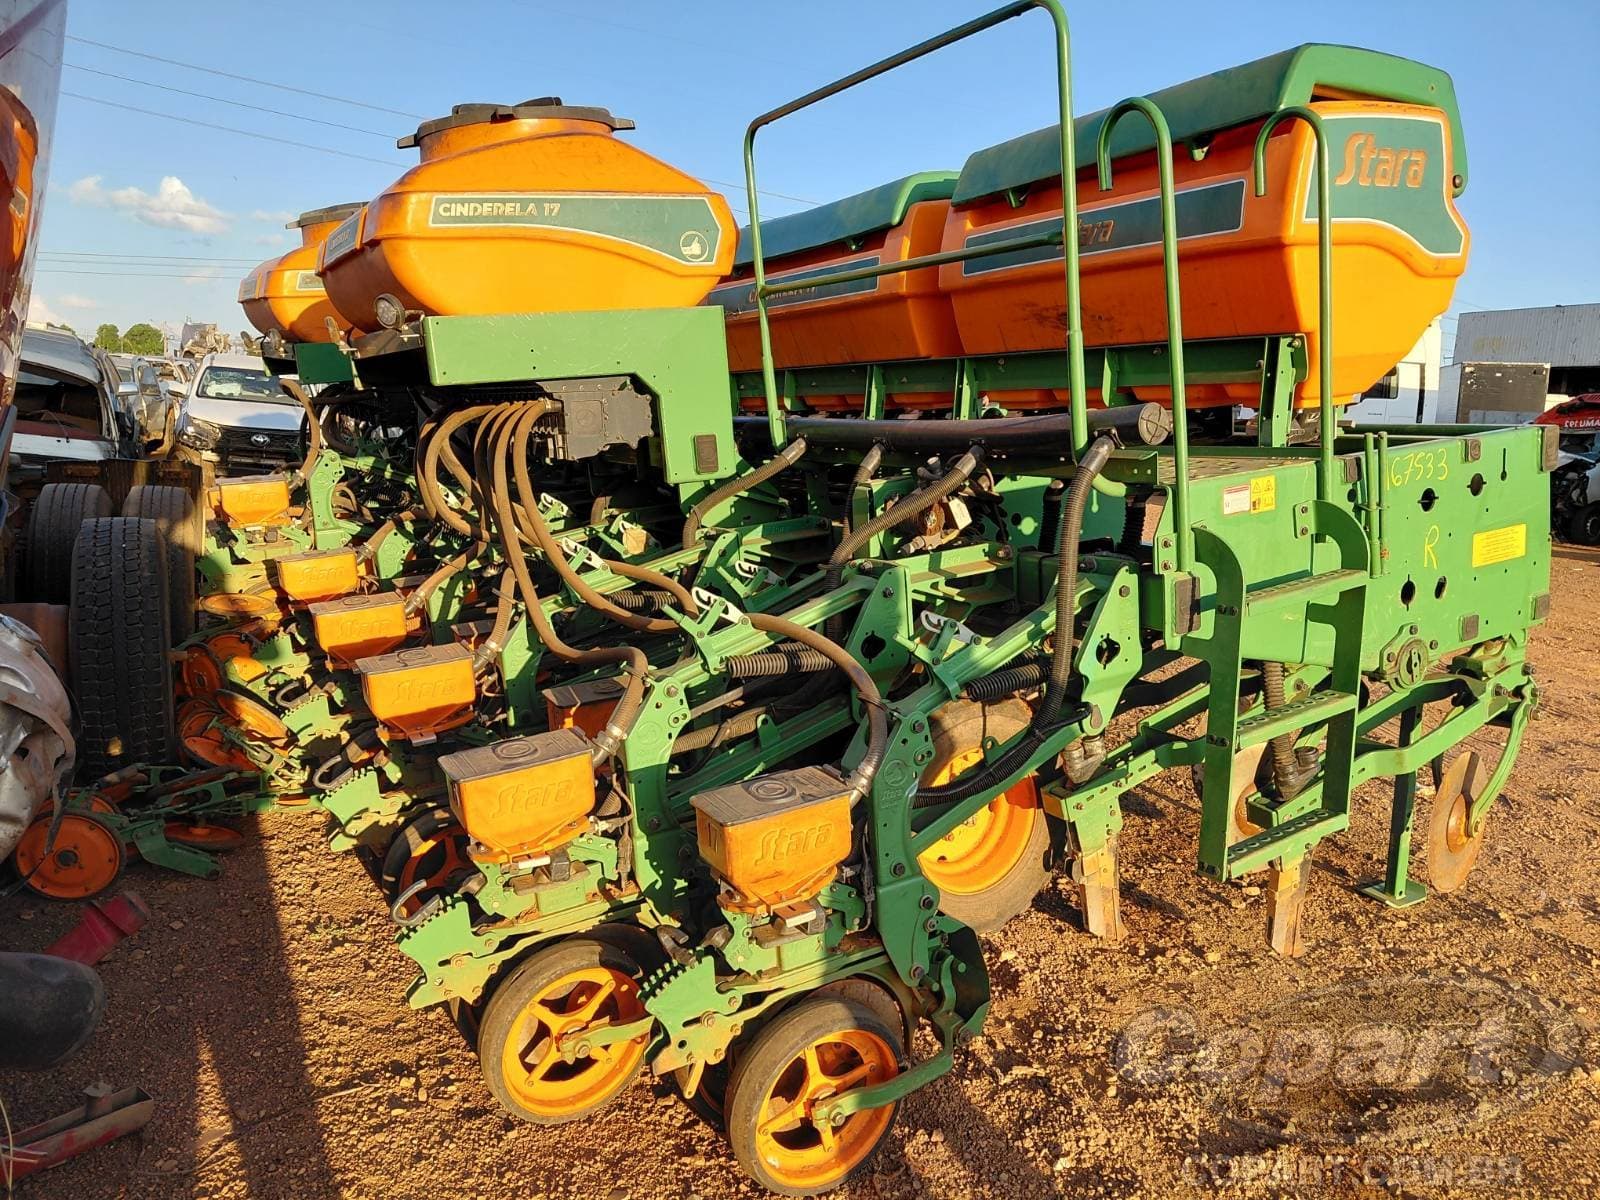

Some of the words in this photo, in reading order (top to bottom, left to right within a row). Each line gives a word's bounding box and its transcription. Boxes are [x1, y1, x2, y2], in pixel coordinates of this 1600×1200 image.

[1335, 131, 1427, 188] Stara
[438, 202, 538, 217] CINDERELA
[543, 202, 561, 217] 17
[1423, 525, 1440, 570] R
[489, 779, 574, 819] Stara
[754, 822, 833, 866] Stara
